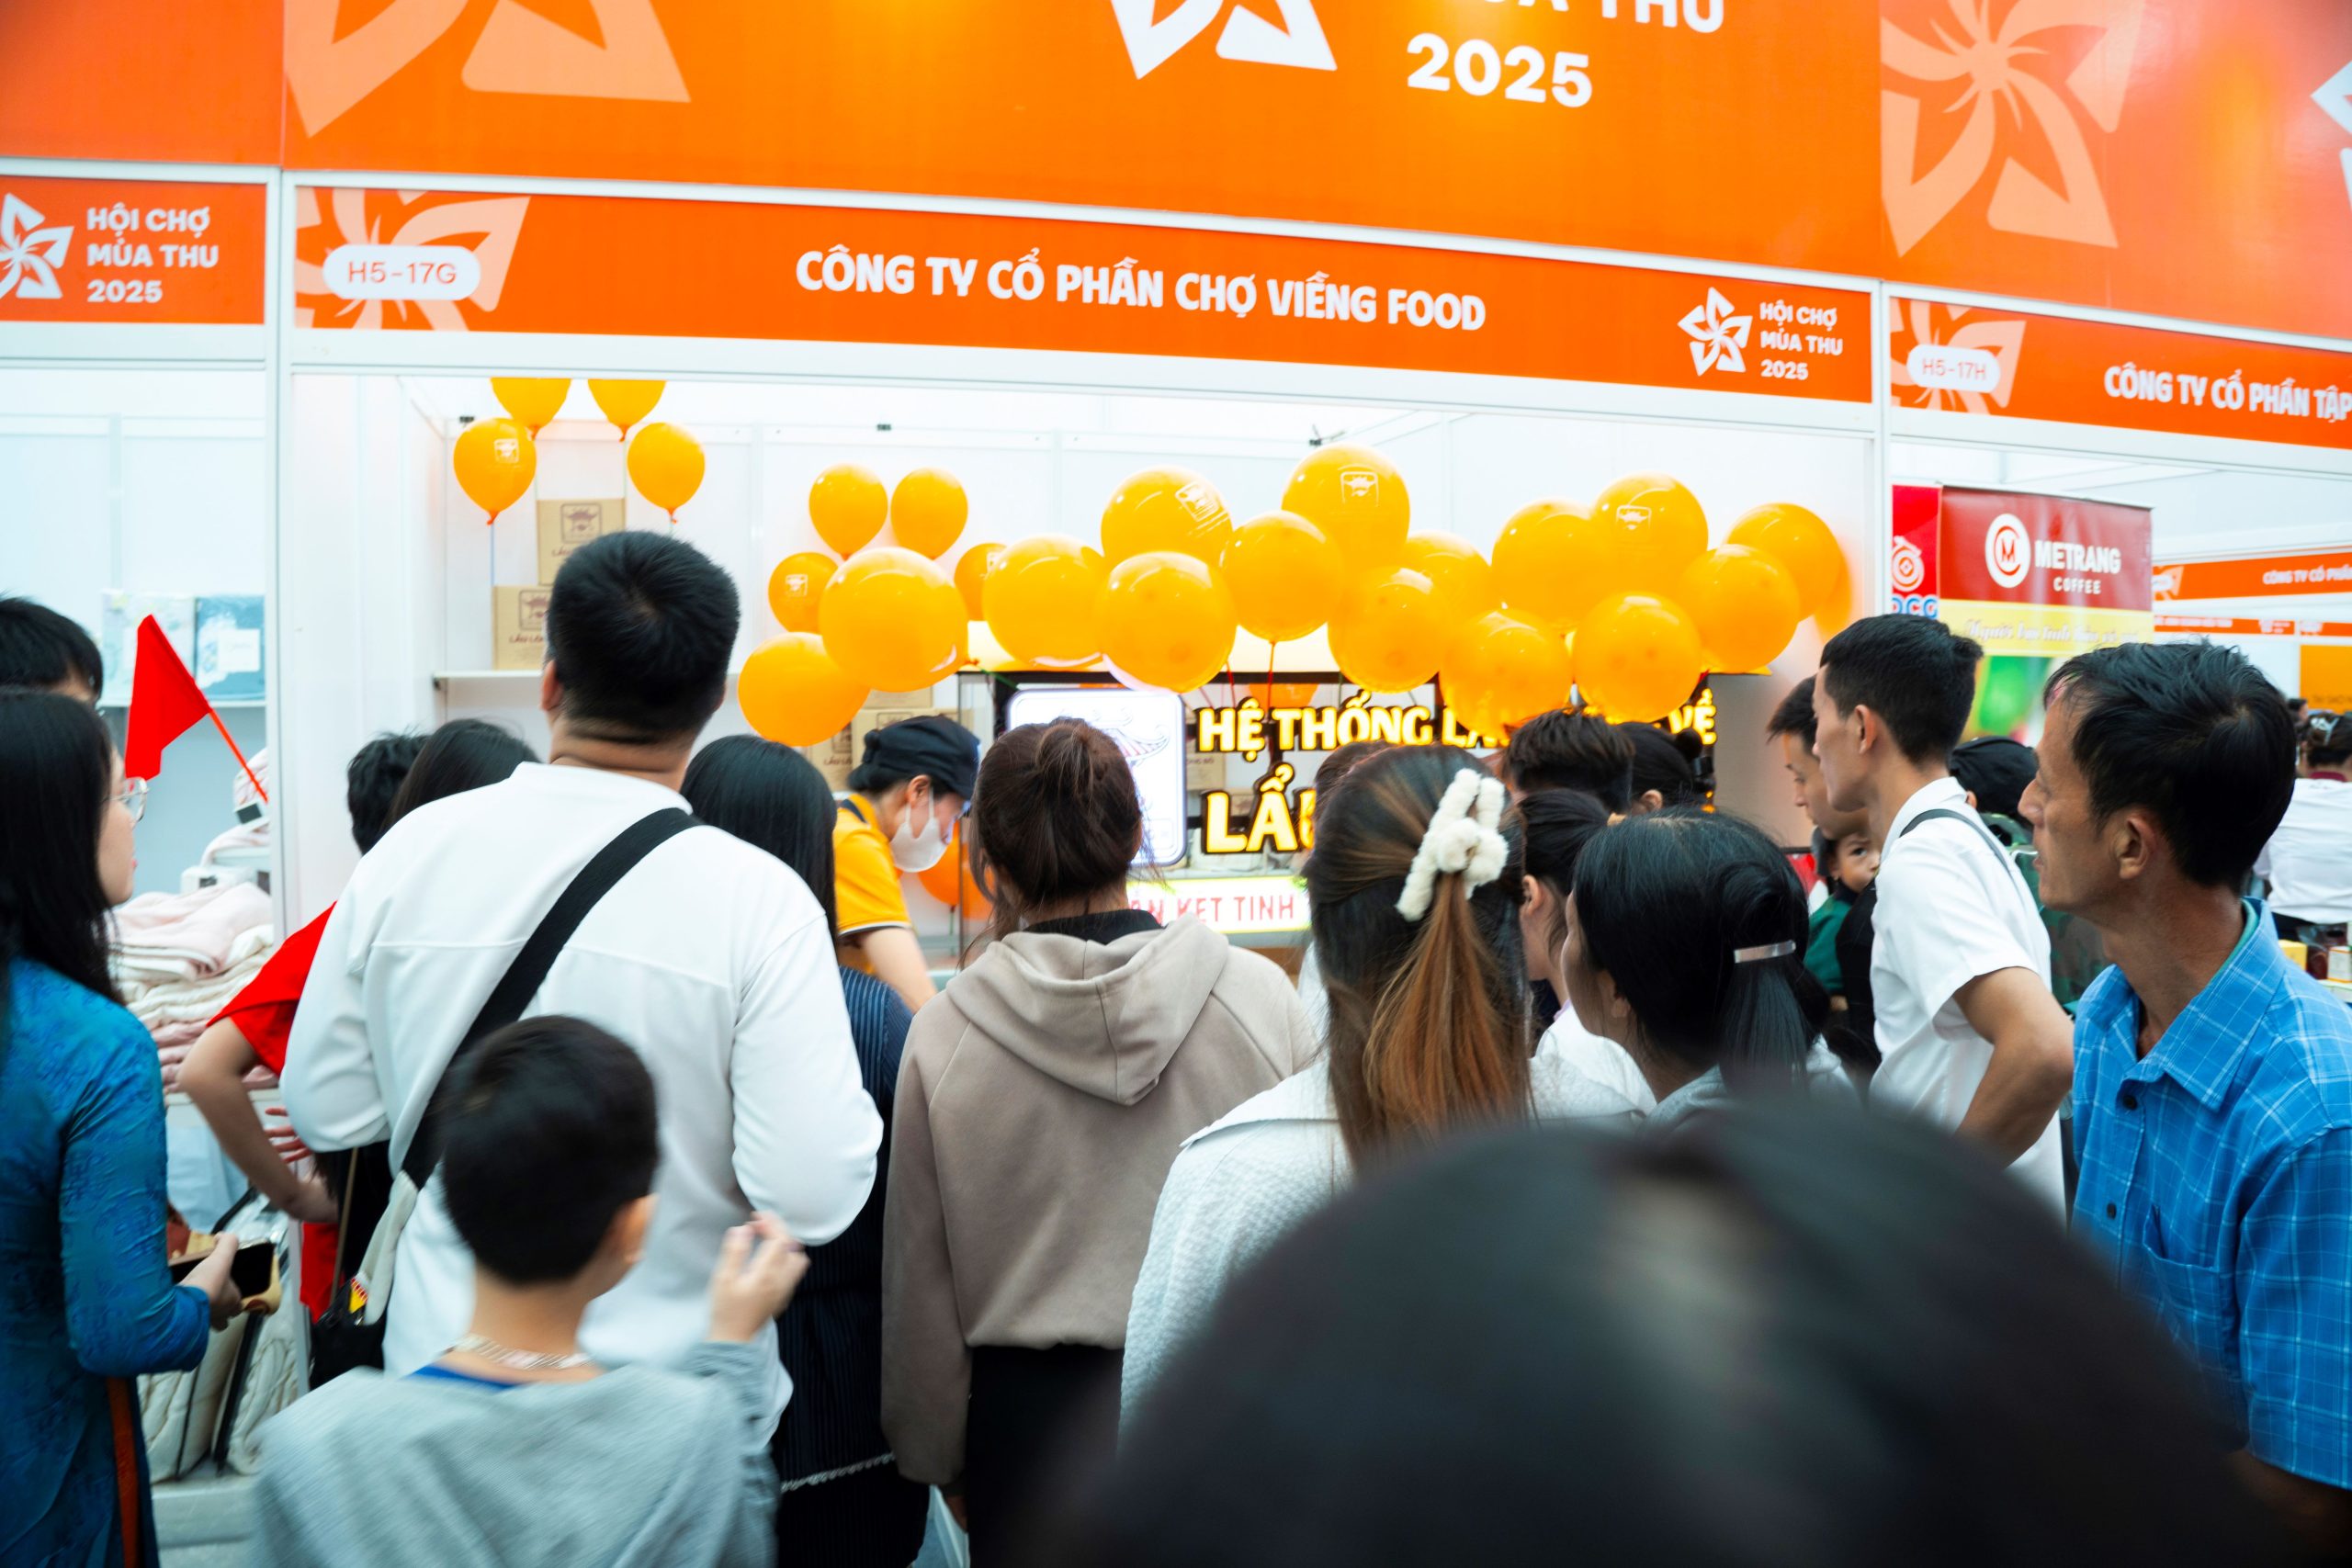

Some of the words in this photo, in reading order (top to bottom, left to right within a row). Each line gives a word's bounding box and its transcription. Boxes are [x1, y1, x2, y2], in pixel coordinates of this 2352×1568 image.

[1407, 32, 1593, 108] 2025
[87, 201, 140, 238] HỘI
[145, 206, 210, 239] CHỢ
[159, 243, 220, 268] THU
[348, 261, 458, 285] H5-17G
[796, 243, 915, 295] CÔNG
[925, 256, 978, 298] TY
[987, 247, 1046, 301] CỔ
[1057, 256, 1164, 309] PHẦN
[1174, 272, 1257, 319] CHỢ
[1387, 288, 1487, 332] FOOD
[86, 278, 164, 304] 2025
[1759, 299, 1793, 327] HỘI
[1796, 306, 1838, 333] CHỢ
[1805, 334, 1844, 356] THU
[1760, 358, 1809, 381] 2025
[1922, 356, 1987, 381] H5-17H
[2103, 361, 2174, 403] CÔNG
[2176, 373, 2209, 407] TY
[2210, 368, 2245, 411] CỔ
[2248, 377, 2311, 417] PHẦN
[2312, 384, 2352, 423] TẬP
[2033, 539, 2122, 575] METRANG
[2052, 576, 2102, 595] COFFEE
[1197, 695, 1266, 762] HỆ
[1271, 690, 1433, 751] THỐNG
